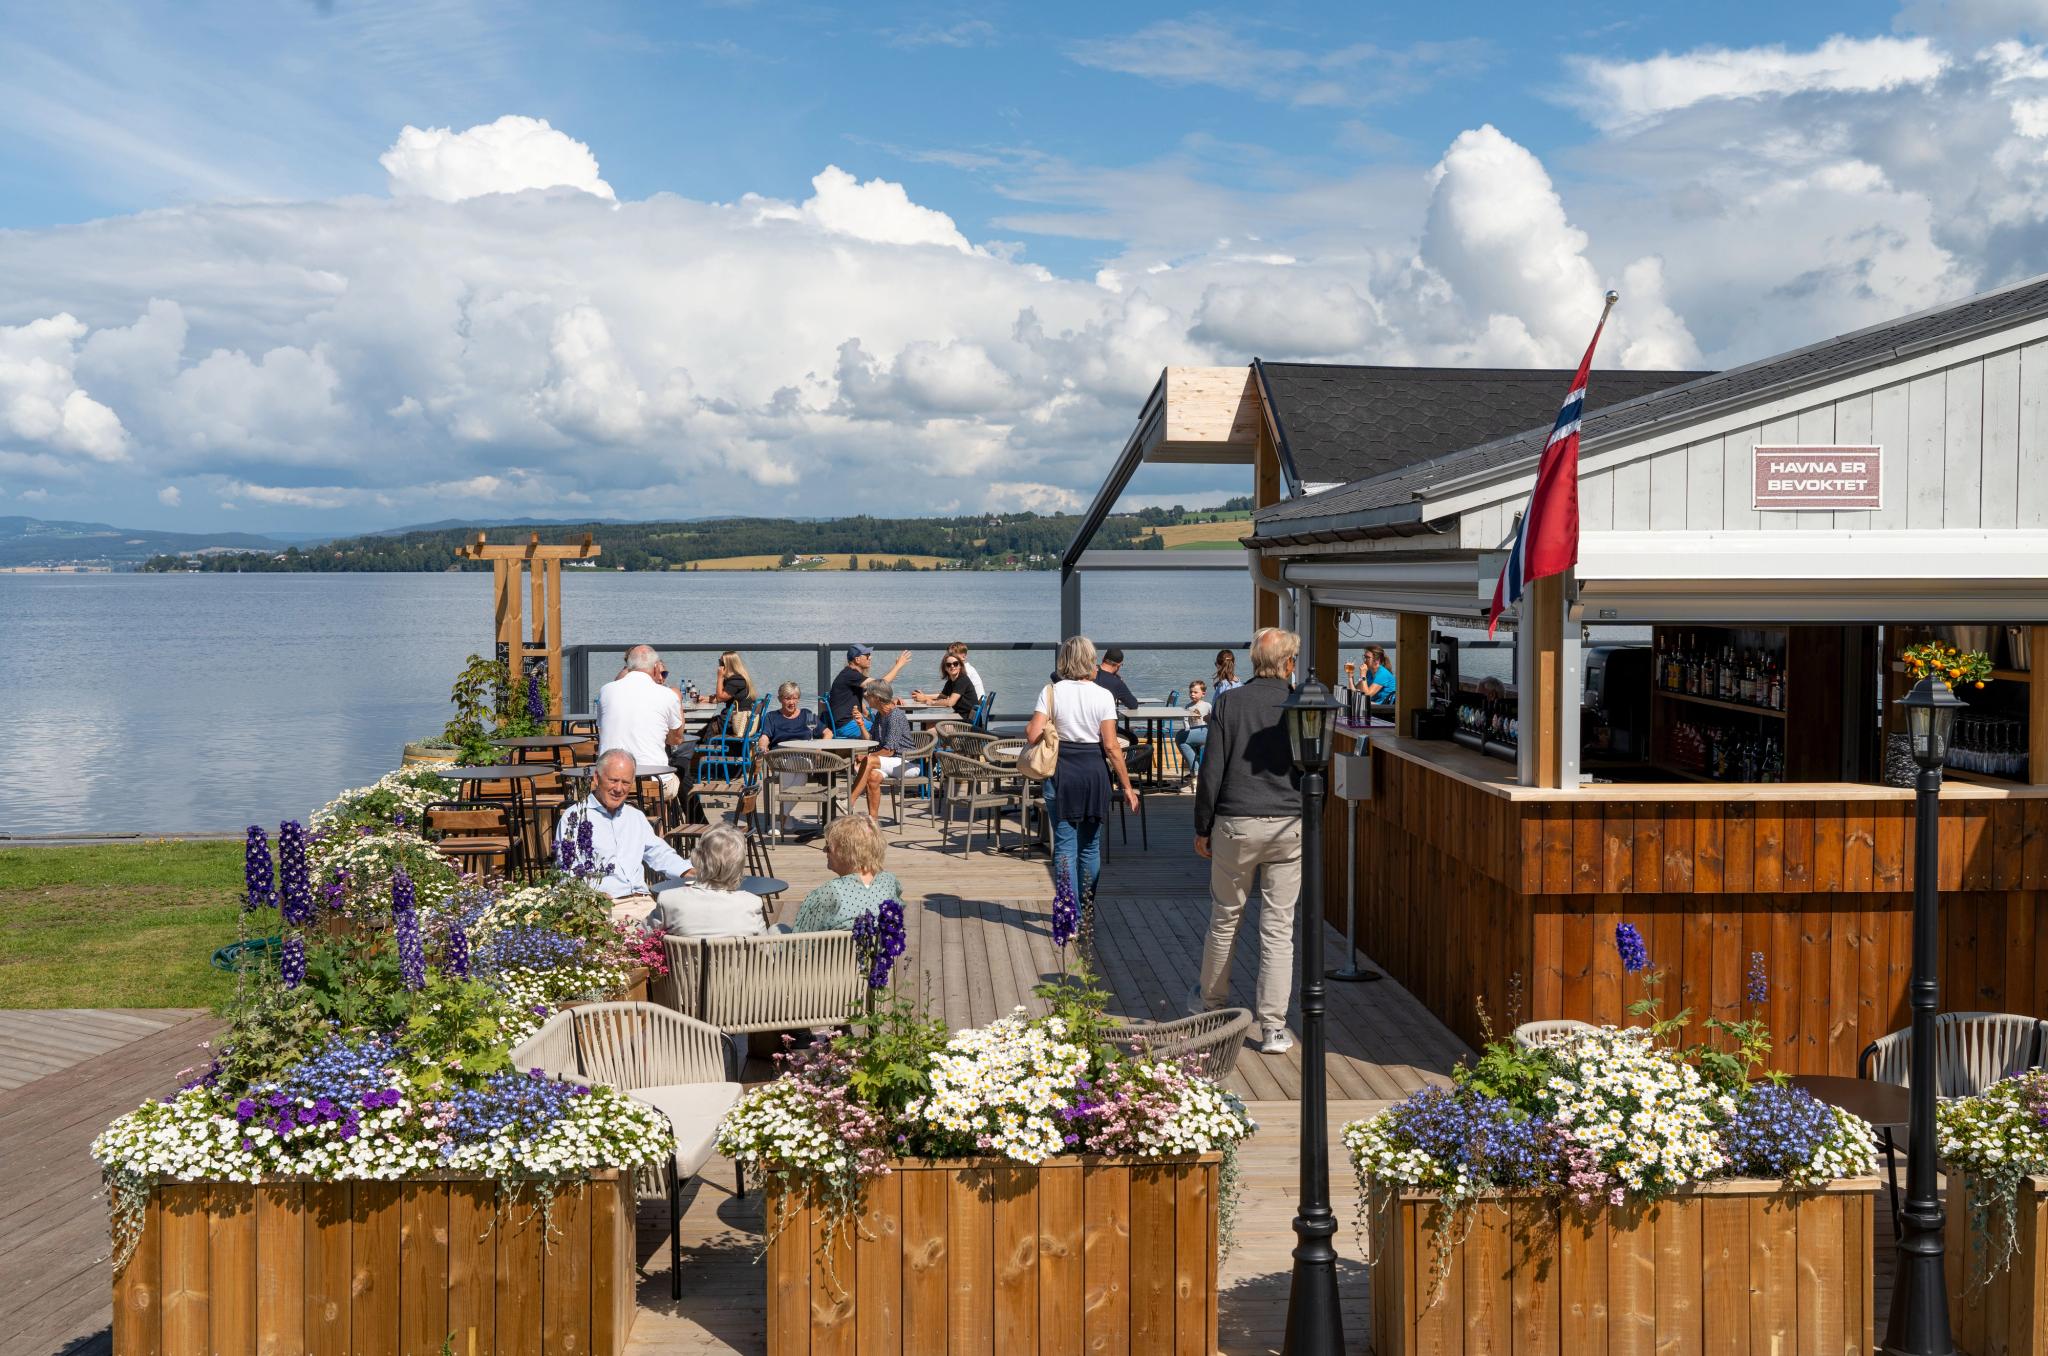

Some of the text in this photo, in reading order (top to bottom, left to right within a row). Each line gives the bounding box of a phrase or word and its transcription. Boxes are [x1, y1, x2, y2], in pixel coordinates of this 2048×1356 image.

[1770, 462, 1866, 473] HAVNA ER
[1767, 480, 1867, 491] BEVOKTET
